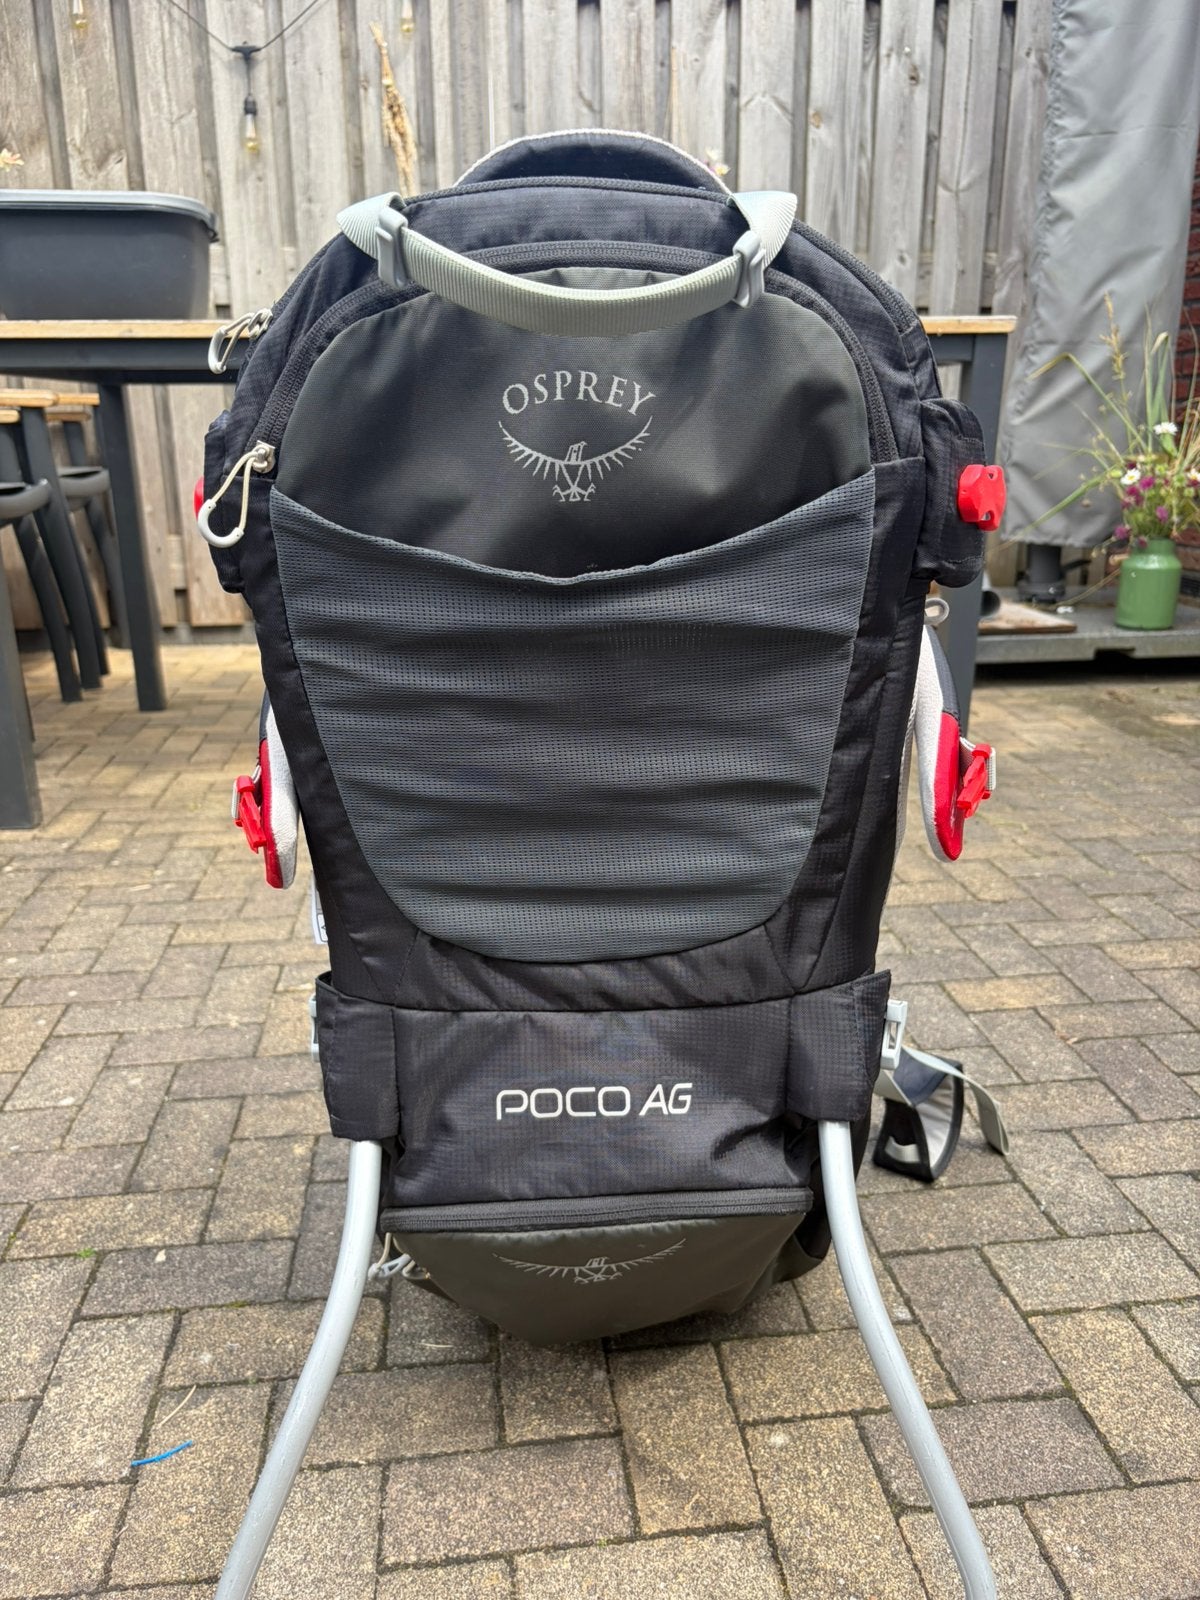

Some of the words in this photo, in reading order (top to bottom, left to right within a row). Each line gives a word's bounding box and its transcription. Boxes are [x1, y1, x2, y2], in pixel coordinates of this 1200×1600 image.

[502, 370, 656, 416] OSPREY
[496, 1086, 631, 1120] POCO
[638, 1082, 693, 1117] AG
